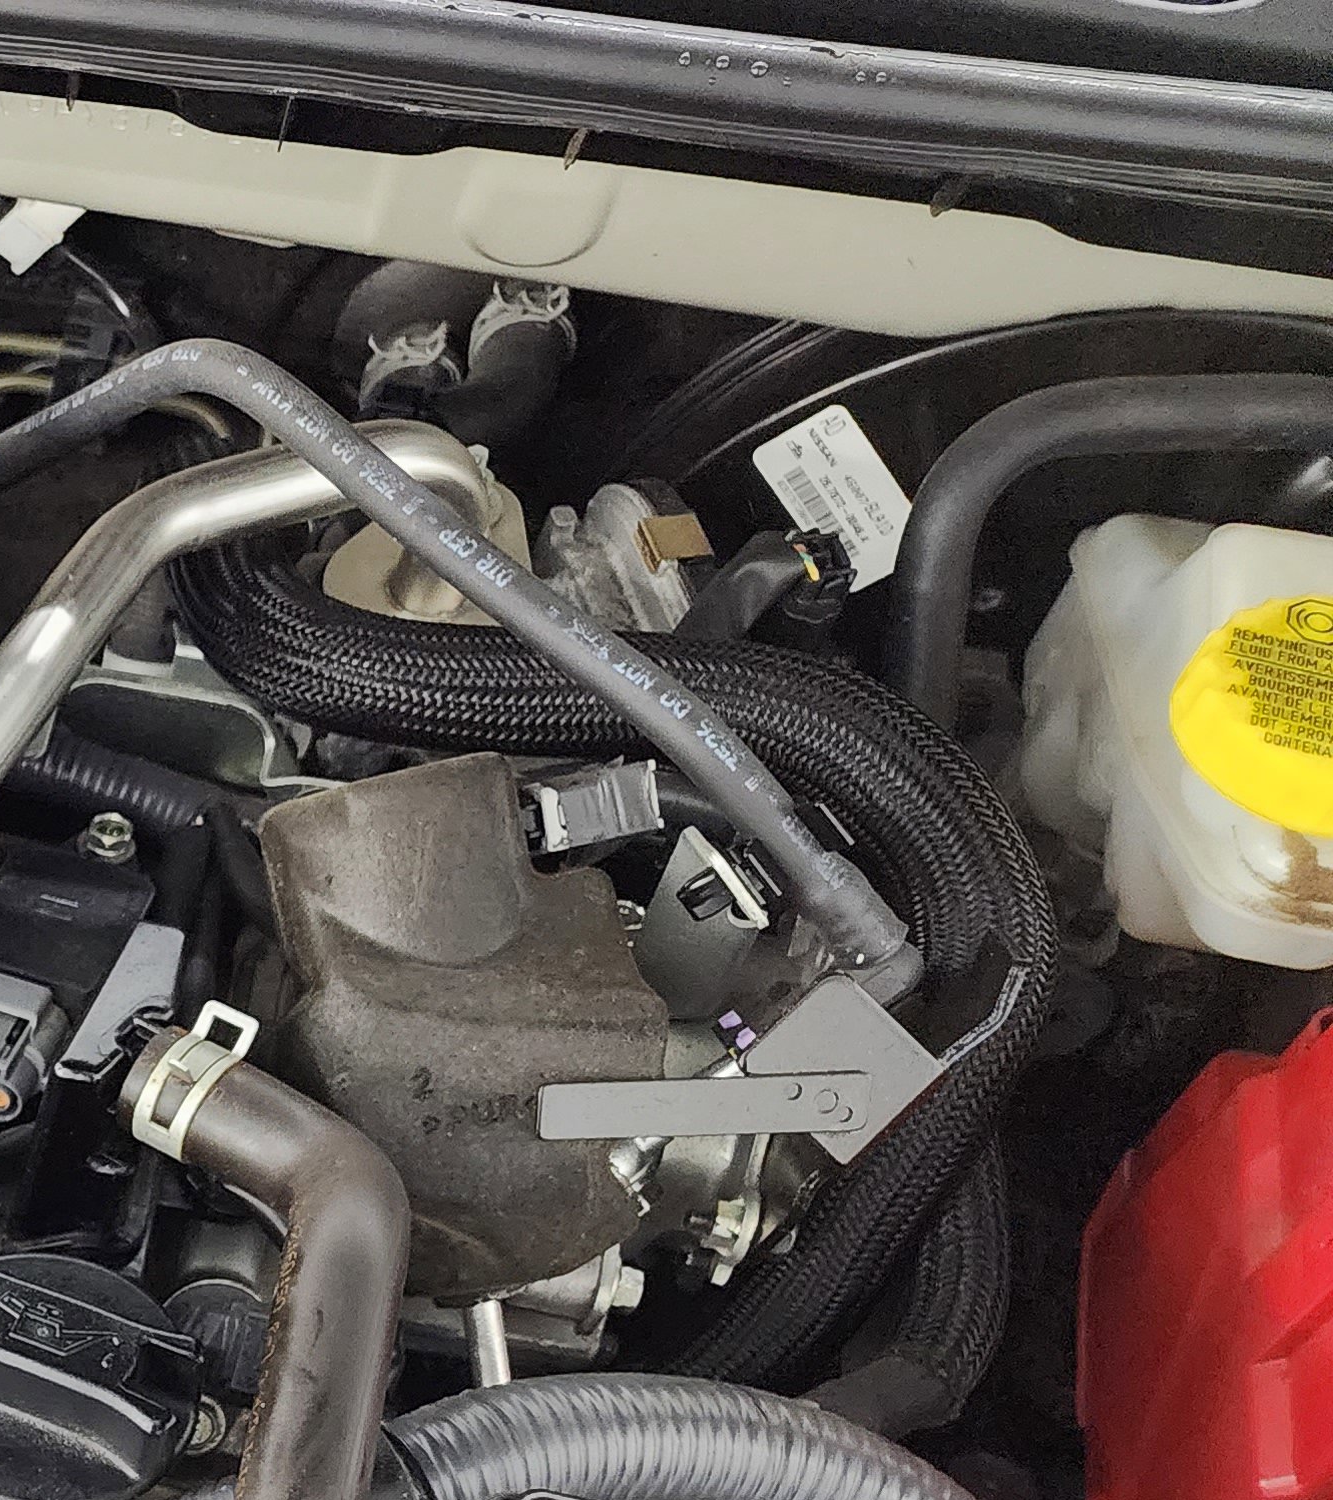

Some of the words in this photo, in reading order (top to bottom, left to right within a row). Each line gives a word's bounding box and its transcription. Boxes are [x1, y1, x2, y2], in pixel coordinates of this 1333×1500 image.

[1229, 640, 1272, 659] FLUID
[1277, 652, 1318, 670] FROM
[1227, 683, 1282, 705] AVANT
[1285, 696, 1304, 712] DE
[1248, 674, 1314, 699] BOUCHON
[1250, 714, 1278, 730] DOT
[1283, 722, 1293, 735] 3
